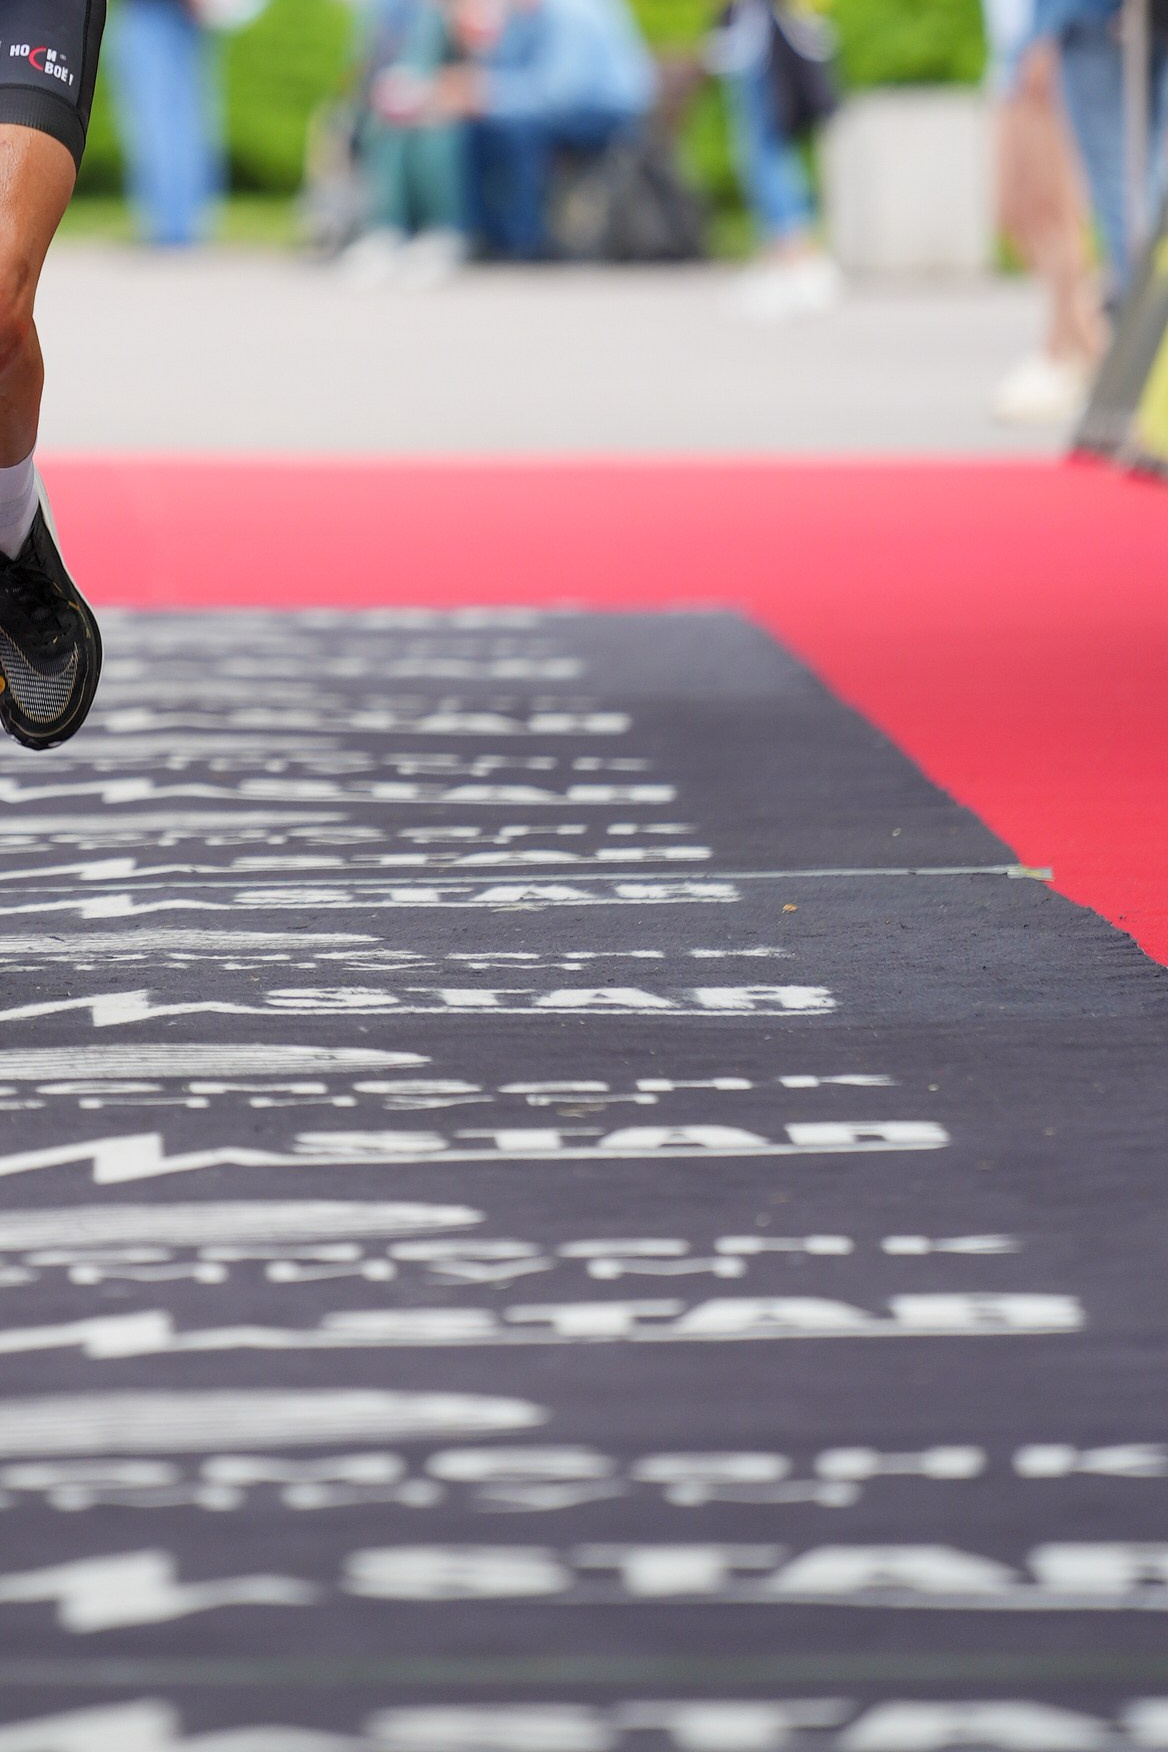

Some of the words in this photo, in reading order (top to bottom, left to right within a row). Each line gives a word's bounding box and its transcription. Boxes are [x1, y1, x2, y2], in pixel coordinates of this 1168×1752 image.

[234, 883, 741, 904] STAR
[263, 985, 836, 1009] STAR
[293, 1120, 950, 1155] STAR
[322, 1293, 1084, 1338] STAR
[368, 1696, 1168, 1752] STA
